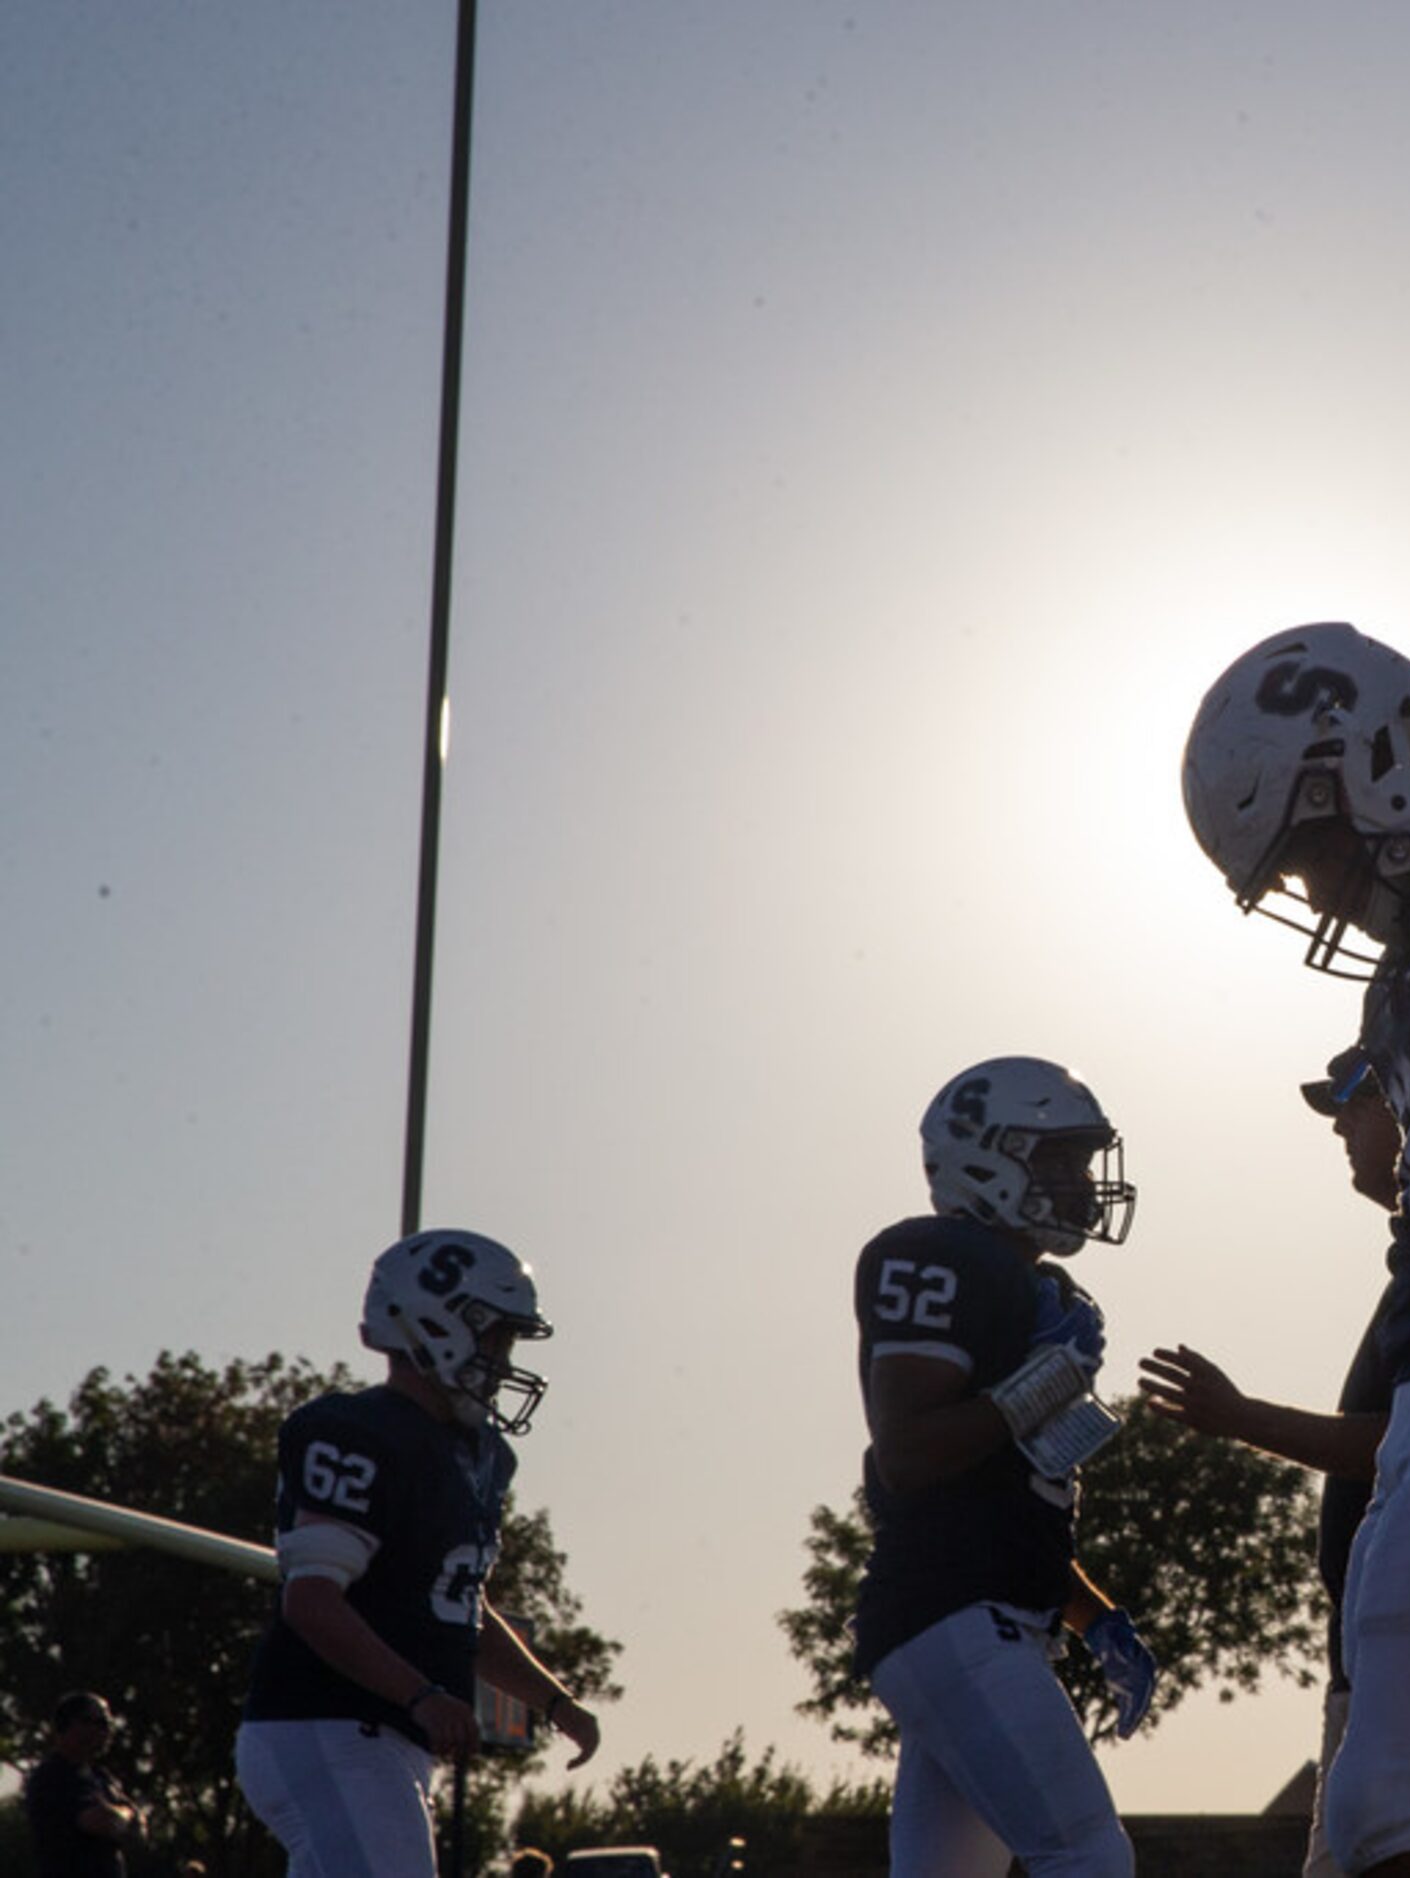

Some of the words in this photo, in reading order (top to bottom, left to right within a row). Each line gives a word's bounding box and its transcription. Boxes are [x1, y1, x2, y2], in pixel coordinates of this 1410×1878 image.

[948, 1078, 988, 1139] S
[418, 1245, 474, 1297] S
[873, 1258, 958, 1330] 52
[303, 1440, 377, 1515] 62
